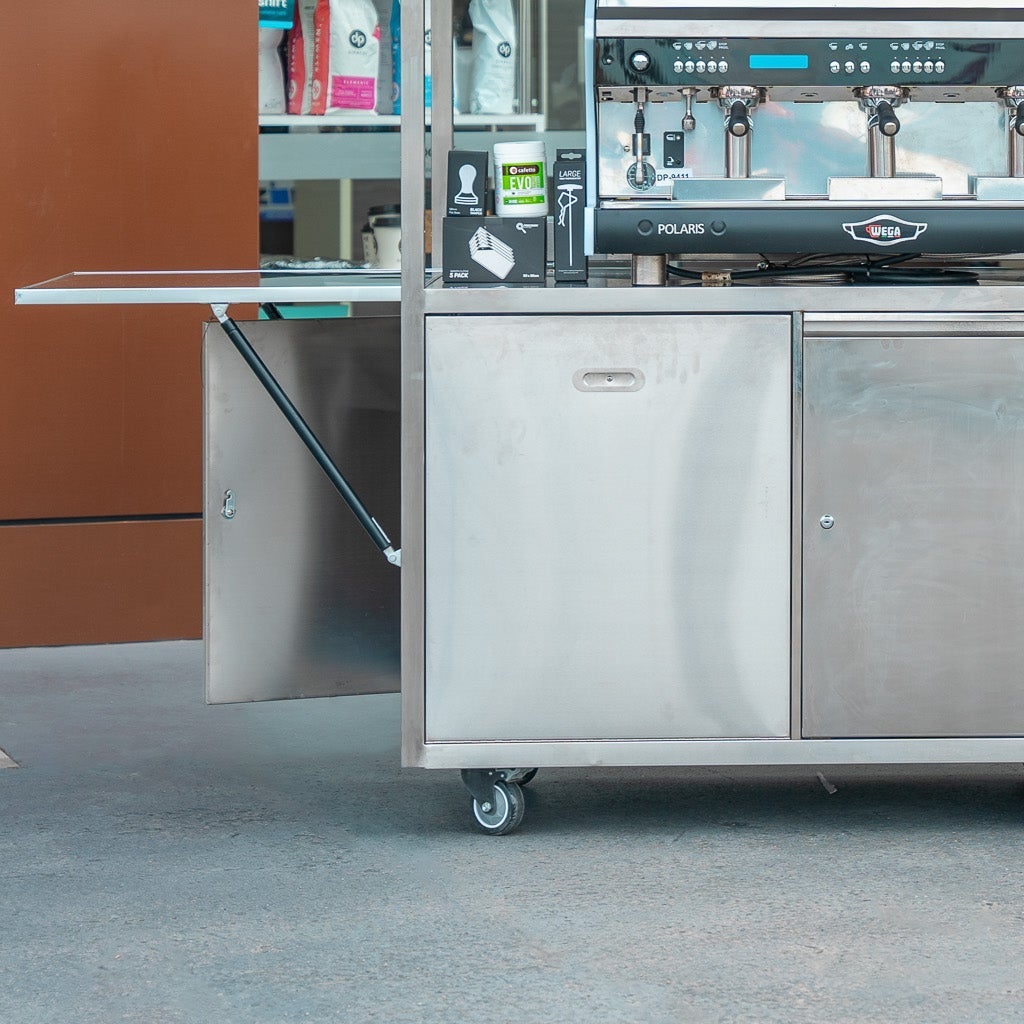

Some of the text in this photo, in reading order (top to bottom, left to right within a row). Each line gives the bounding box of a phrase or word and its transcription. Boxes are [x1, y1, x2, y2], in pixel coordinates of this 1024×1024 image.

[559, 170, 582, 178] LARGE
[510, 176, 531, 190] EVO
[658, 223, 705, 235] POLARIS
[870, 226, 901, 238] WEGA
